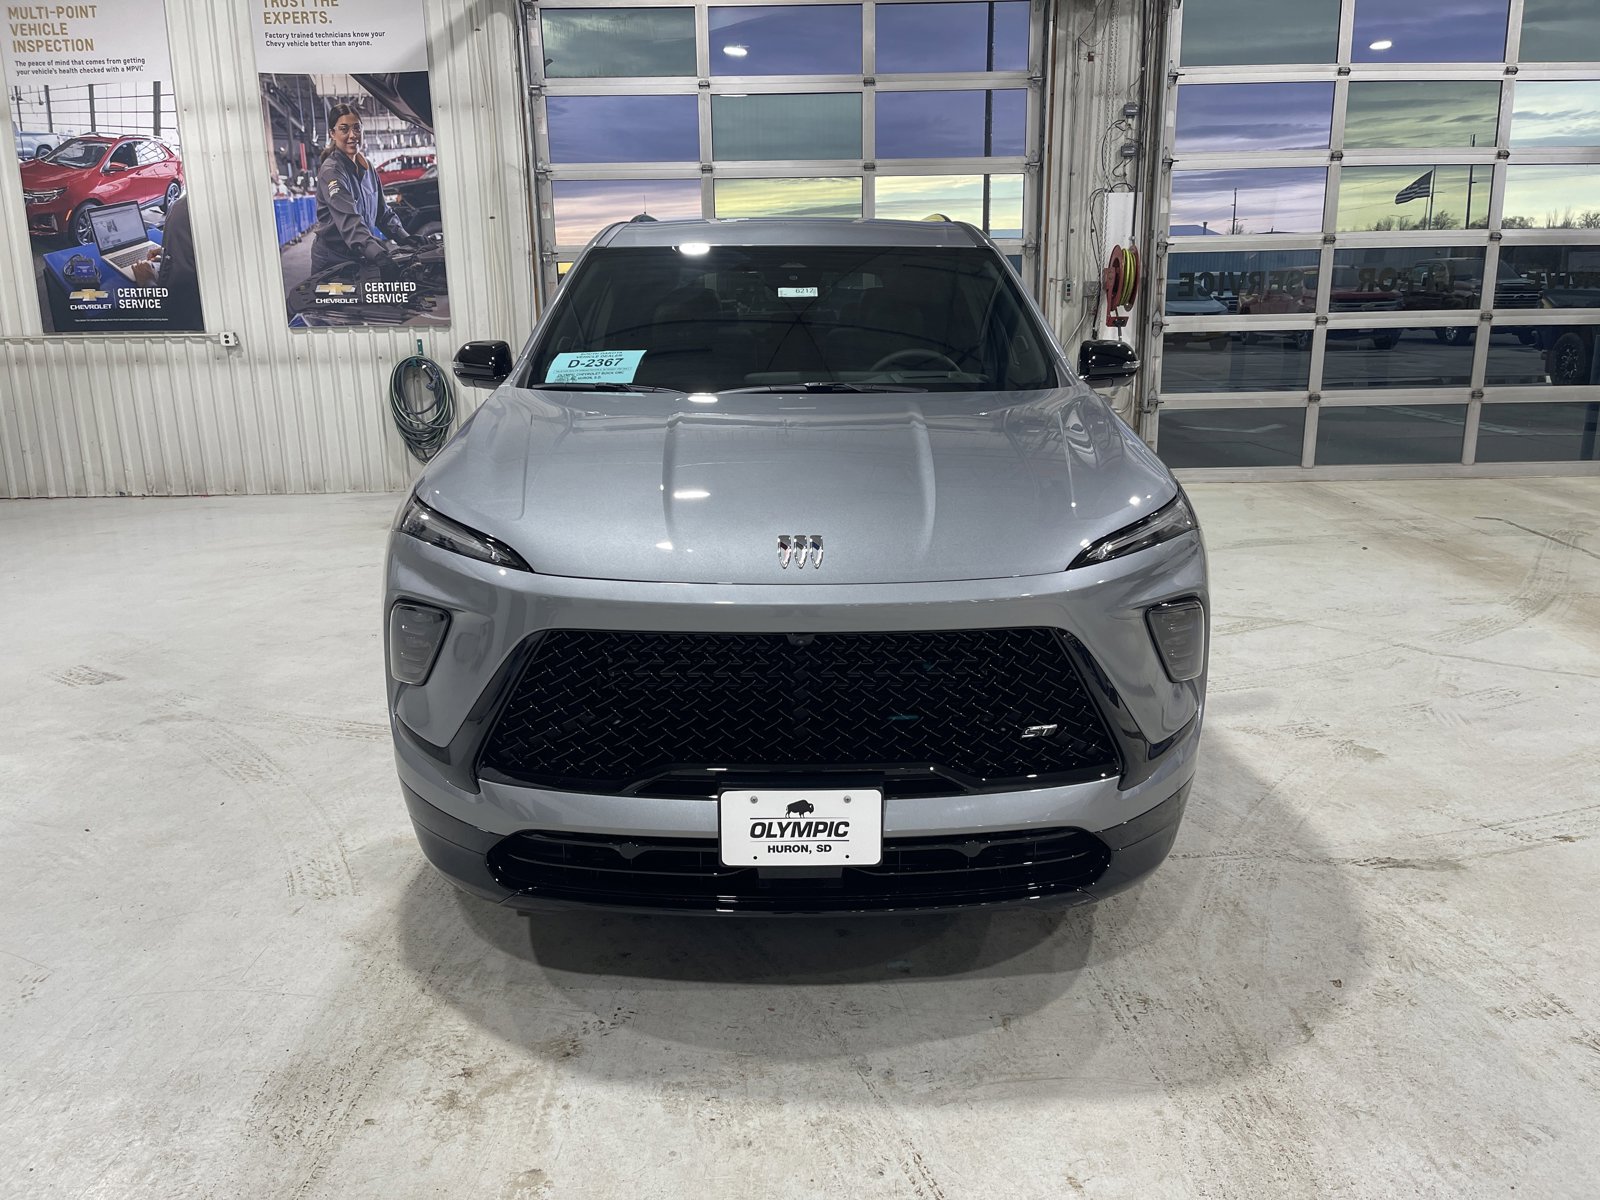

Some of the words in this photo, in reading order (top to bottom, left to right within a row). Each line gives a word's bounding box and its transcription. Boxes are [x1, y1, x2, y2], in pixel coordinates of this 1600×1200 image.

[264, 0, 305, 8] TRUST
[8, 5, 97, 20] MULTI-POINT
[263, 11, 333, 25] EXPERTS.
[10, 23, 68, 36] VEHICLE
[370, 31, 385, 39] your
[13, 39, 95, 53] INSPECTION
[265, 40, 285, 48] Chevy
[122, 57, 145, 65] getting
[364, 282, 416, 292] CERTIFIED
[117, 287, 169, 298] CERTIFIED
[365, 293, 409, 303] SERVICE
[69, 303, 113, 311] CHEVROLET
[119, 299, 161, 309] SERVICE
[567, 358, 624, 368] D-2367
[1021, 724, 1058, 739] ST
[749, 821, 850, 839] OLYMPIC
[767, 844, 812, 854] HURON,
[816, 844, 832, 853] SD
